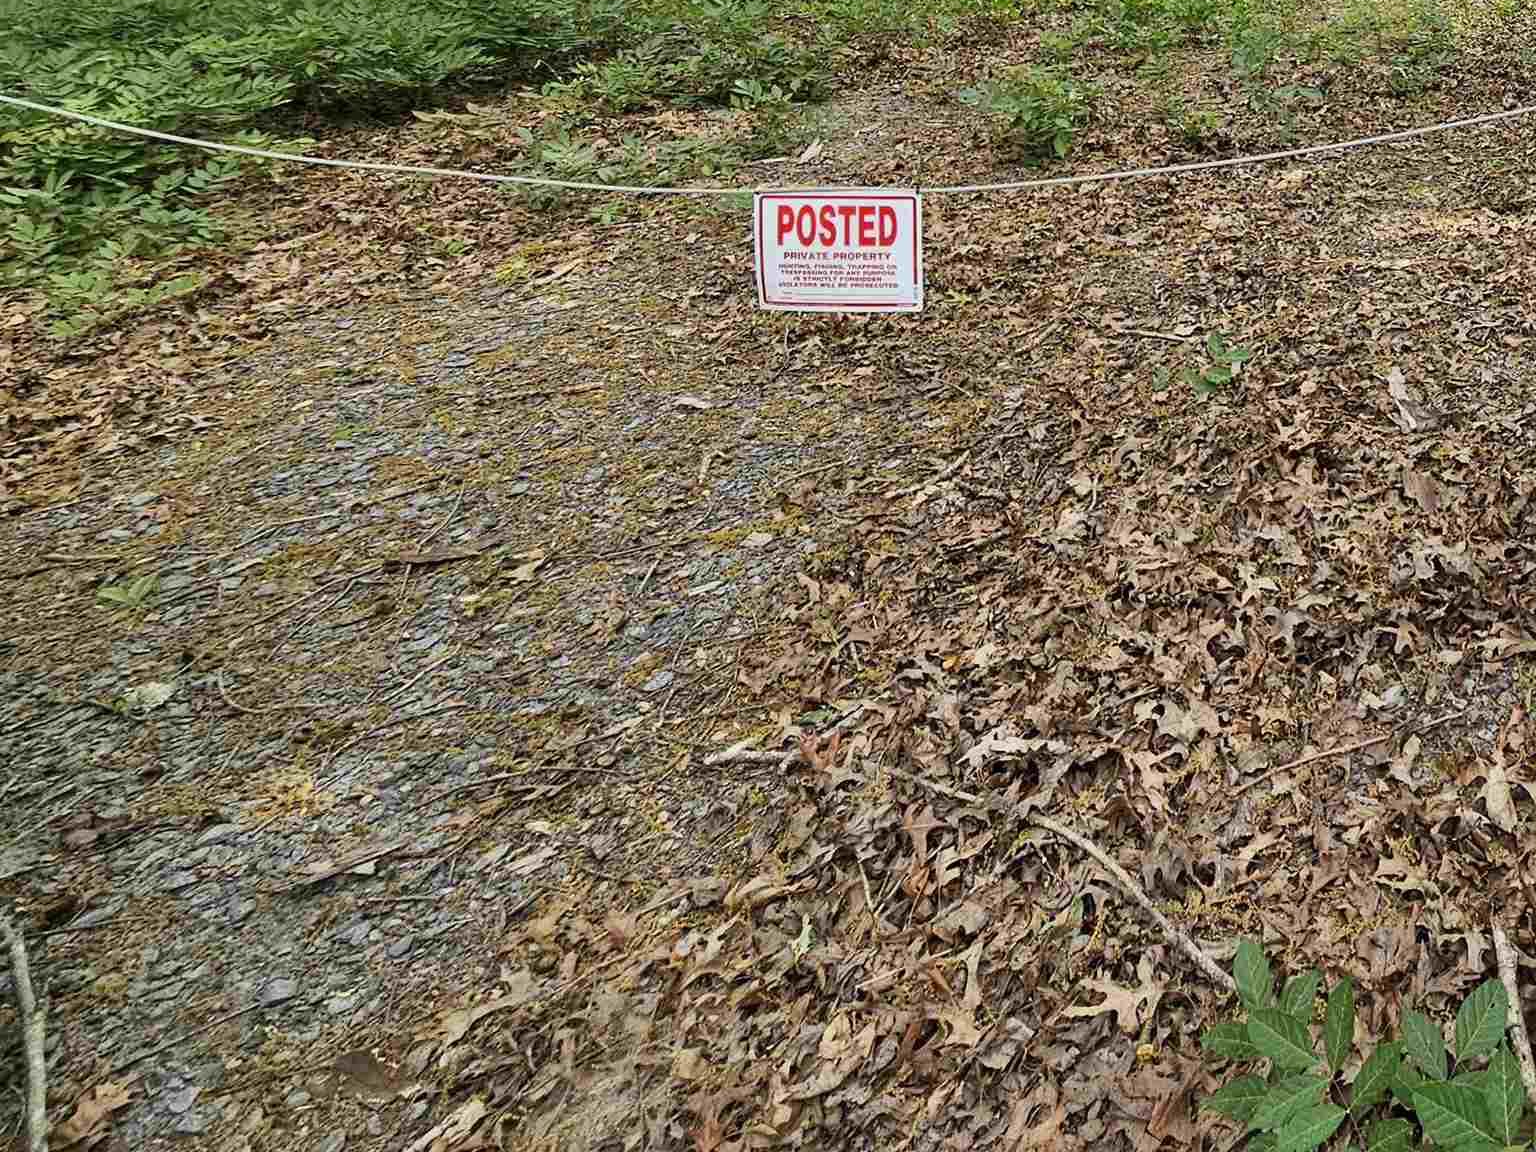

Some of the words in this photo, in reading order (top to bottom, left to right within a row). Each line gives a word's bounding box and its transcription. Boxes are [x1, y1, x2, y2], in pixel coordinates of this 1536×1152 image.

[777, 204, 897, 247] POSTED
[784, 251, 828, 260] PRIVATE
[833, 252, 891, 261] PROPERTY
